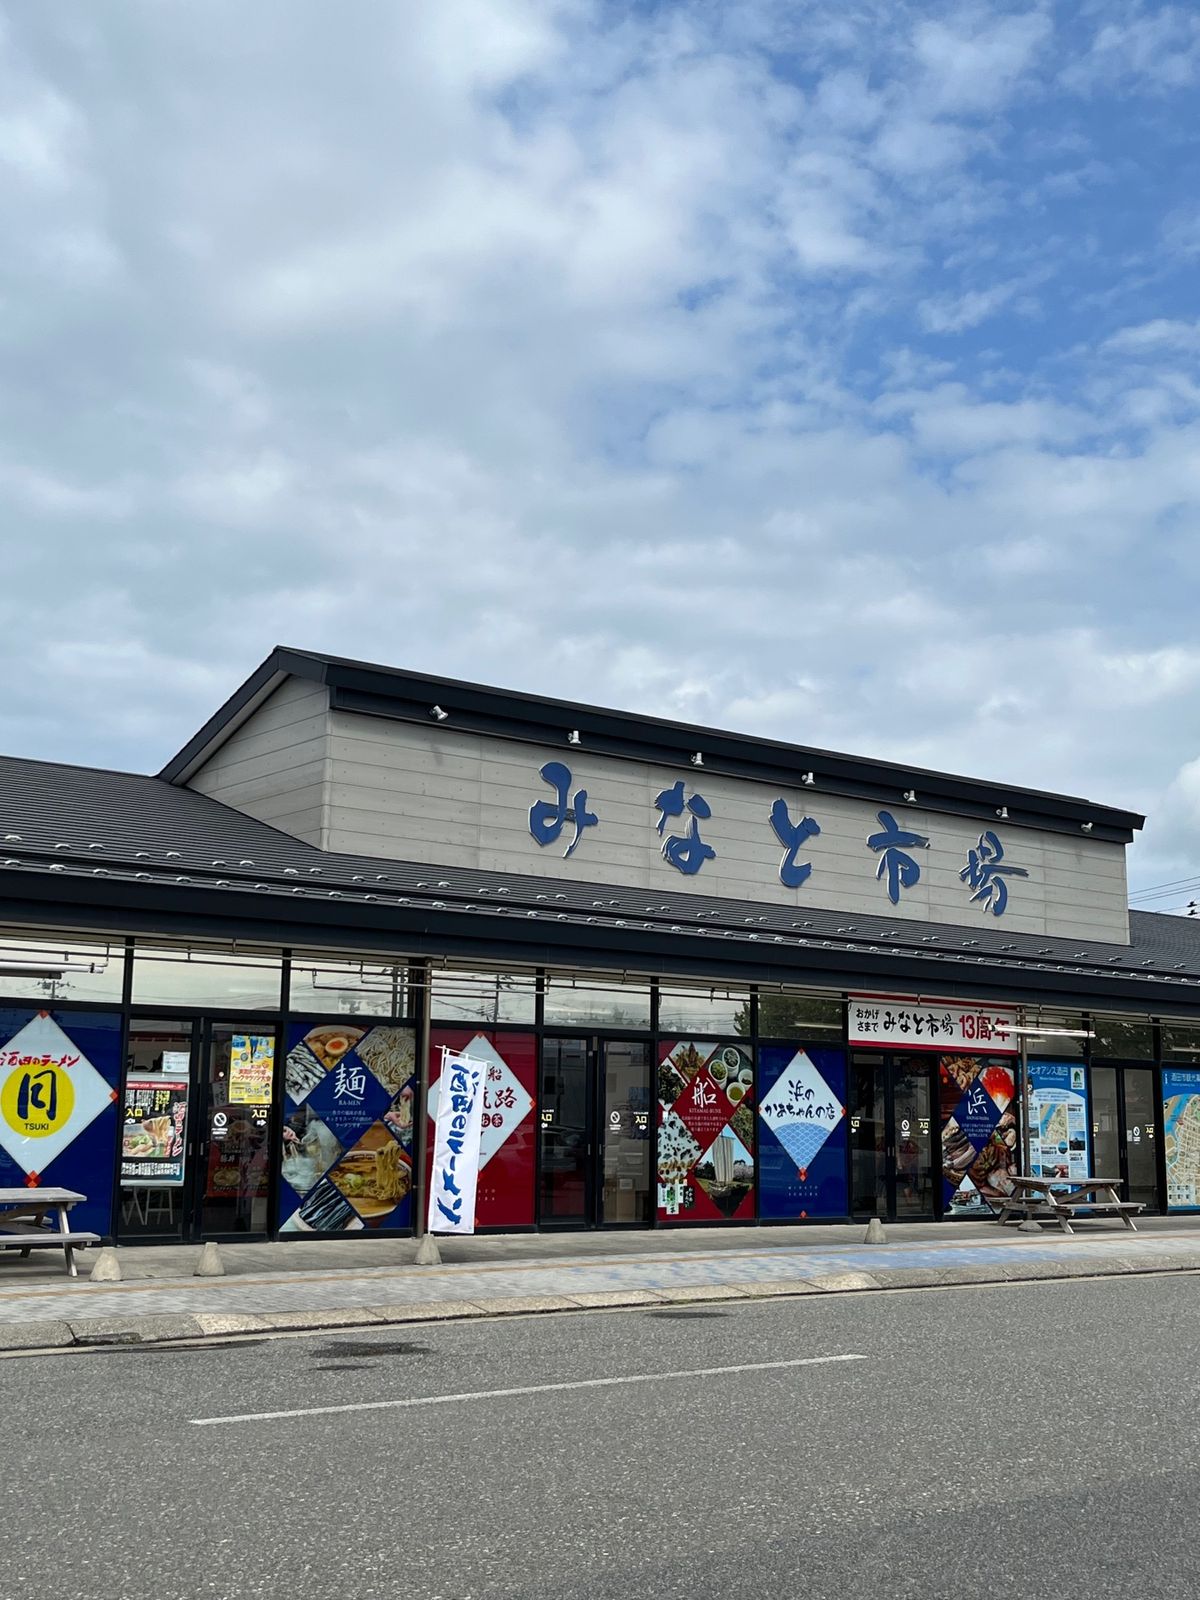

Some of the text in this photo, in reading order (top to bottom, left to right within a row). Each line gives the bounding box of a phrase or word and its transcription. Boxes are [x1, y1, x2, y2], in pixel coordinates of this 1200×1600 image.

[528, 761, 1029, 917] みなと市場
[856, 1008, 879, 1019] おかげ
[857, 1021, 879, 1033] さまで
[883, 1011, 1011, 1042] みなと市場 13周年
[0, 1051, 81, 1067] 酒田のラーメン
[333, 1063, 366, 1100] 麺
[788, 1080, 815, 1102] 浜の
[691, 1076, 717, 1108] 船
[967, 1087, 987, 1115] 浜
[126, 1108, 143, 1117] 入口
[251, 1109, 267, 1118] 入口
[765, 1102, 835, 1120] かあちゃんの店
